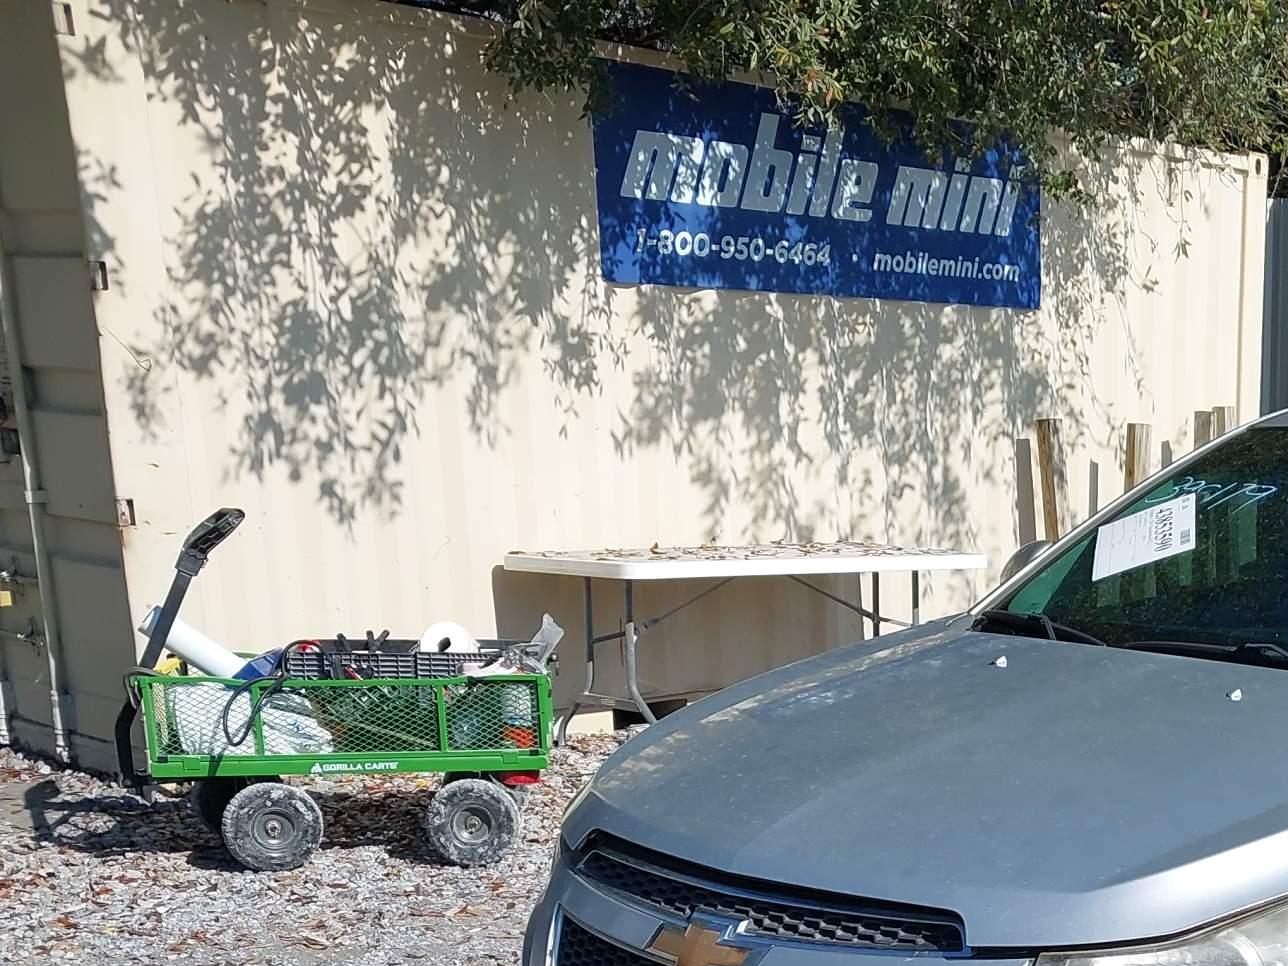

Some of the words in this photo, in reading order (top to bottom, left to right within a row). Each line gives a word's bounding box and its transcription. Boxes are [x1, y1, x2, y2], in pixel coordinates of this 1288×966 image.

[619, 112, 879, 222] mobile
[886, 157, 1022, 237] mini
[636, 227, 831, 267] 1-800-950-6464
[873, 251, 1020, 282] mobilemini.com
[322, 763, 363, 771] GORILLA
[365, 762, 396, 770] CARTS
